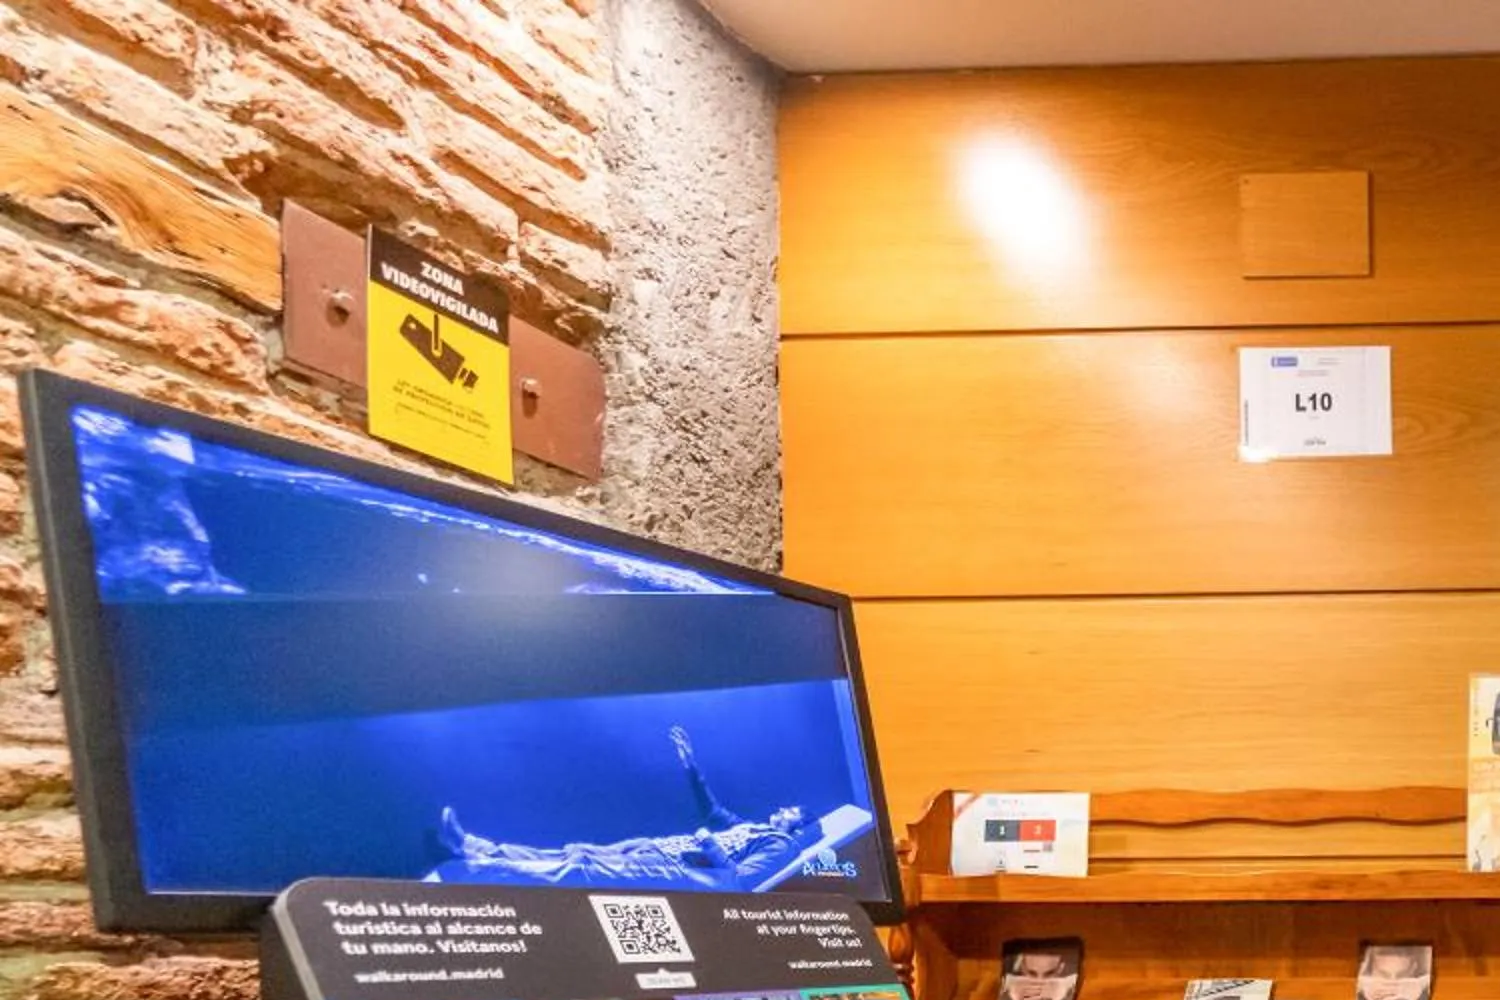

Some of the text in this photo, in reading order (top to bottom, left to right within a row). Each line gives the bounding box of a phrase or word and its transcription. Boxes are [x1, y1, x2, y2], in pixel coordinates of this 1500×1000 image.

[421, 261, 465, 296] ZONA
[380, 261, 499, 334] VIDEOVIGILADA
[1295, 392, 1333, 412] L10
[322, 900, 516, 918] Toda la información
[723, 908, 849, 921] All tourist information
[424, 921, 443, 936] al
[446, 921, 517, 936] alcance
[519, 921, 543, 936] de
[756, 924, 770, 935] at
[771, 924, 797, 937] your
[341, 940, 368, 955] tu
[371, 941, 435, 955] mano.
[817, 937, 843, 948] Visit
[354, 965, 505, 983] walkaround.madrid
